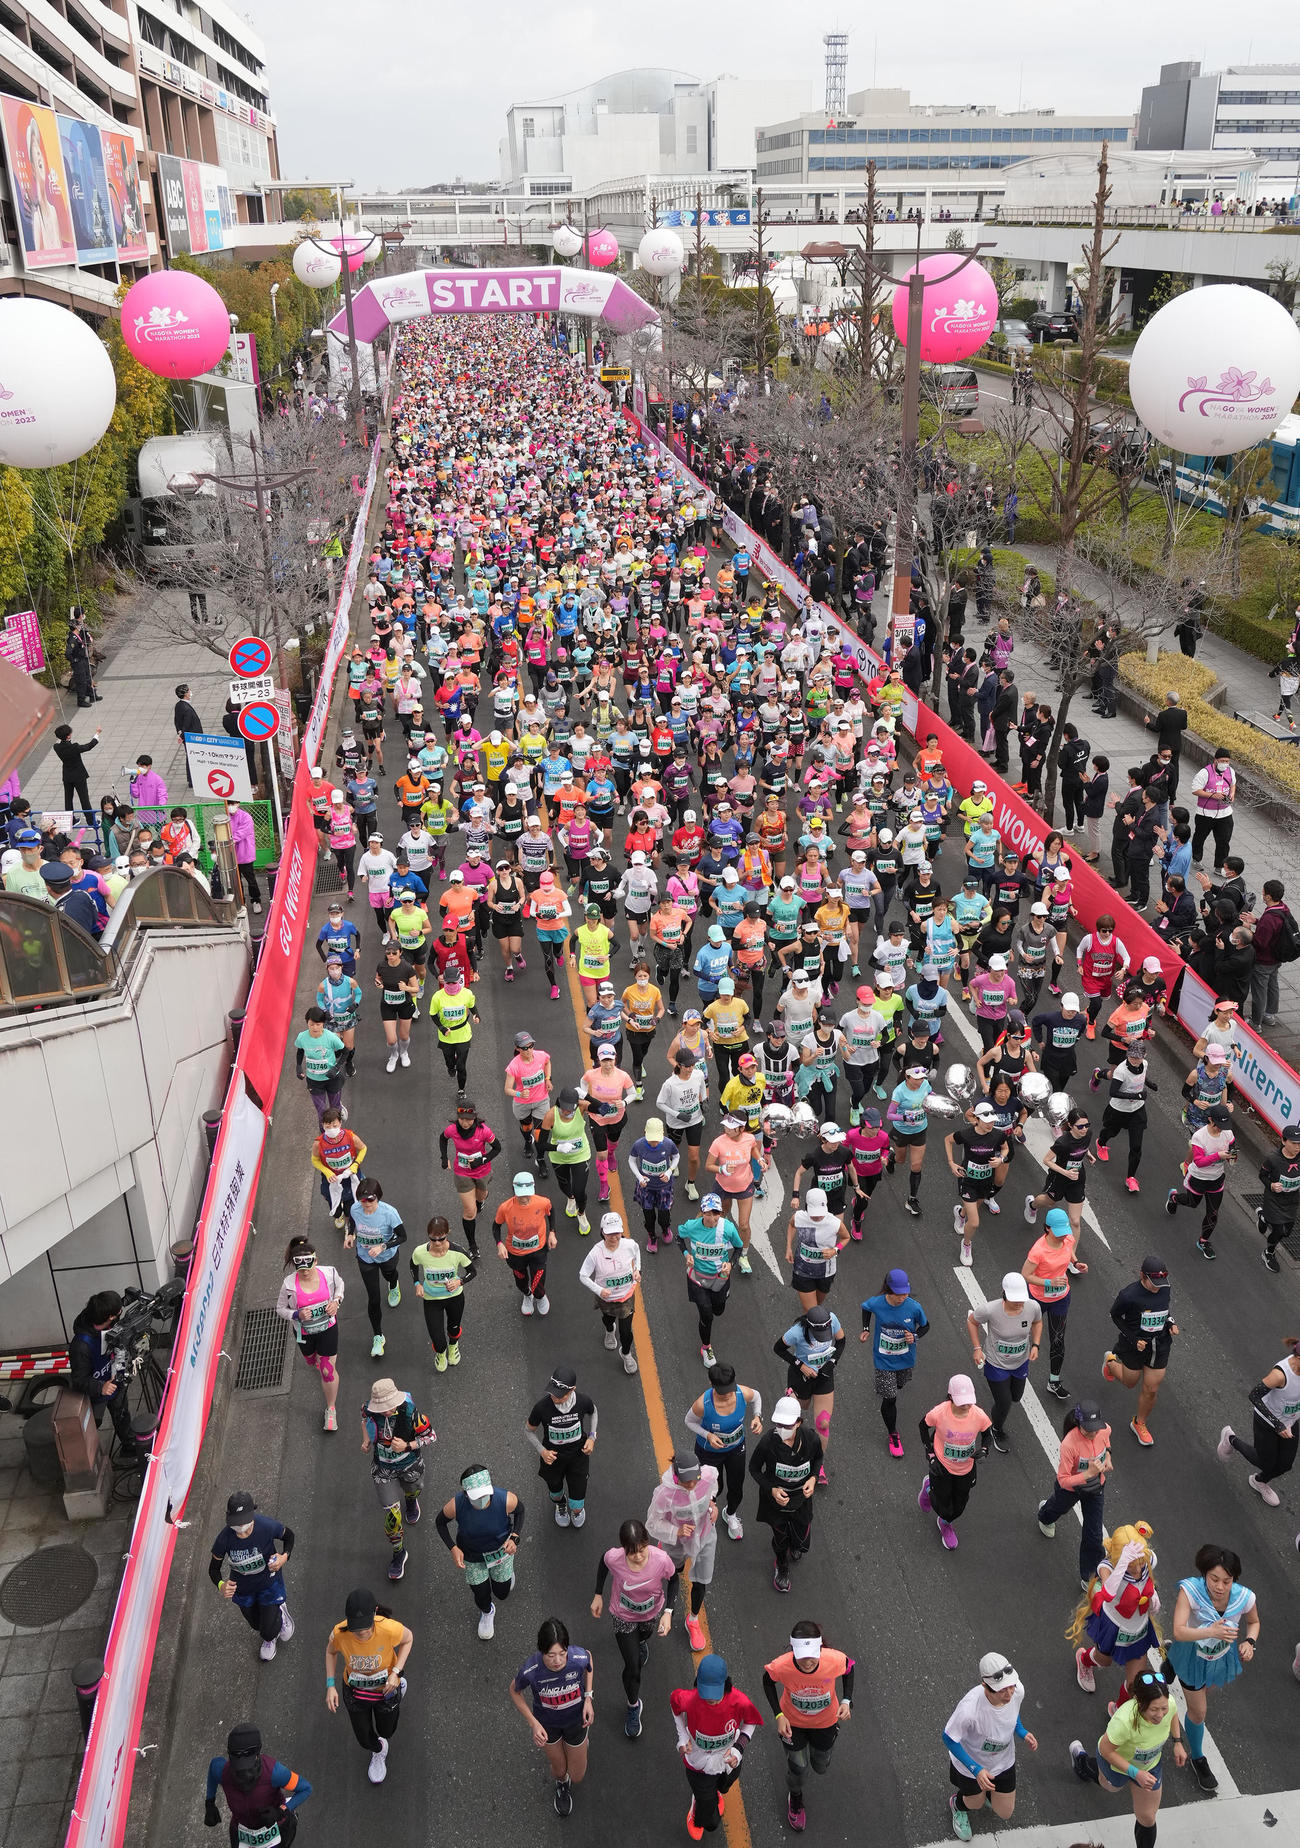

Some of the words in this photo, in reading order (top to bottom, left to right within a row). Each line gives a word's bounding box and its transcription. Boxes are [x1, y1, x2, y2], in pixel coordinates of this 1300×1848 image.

[433, 278, 556, 307] START
[15, 416, 36, 424] 2023
[232, 679, 271, 692] 野球開催日
[280, 914, 292, 956] GO
[1232, 1042, 1293, 1120] Niterra
[968, 1169, 991, 1177] 4:00
[801, 1248, 824, 1259] C1202
[238, 1827, 277, 1846] D13860
